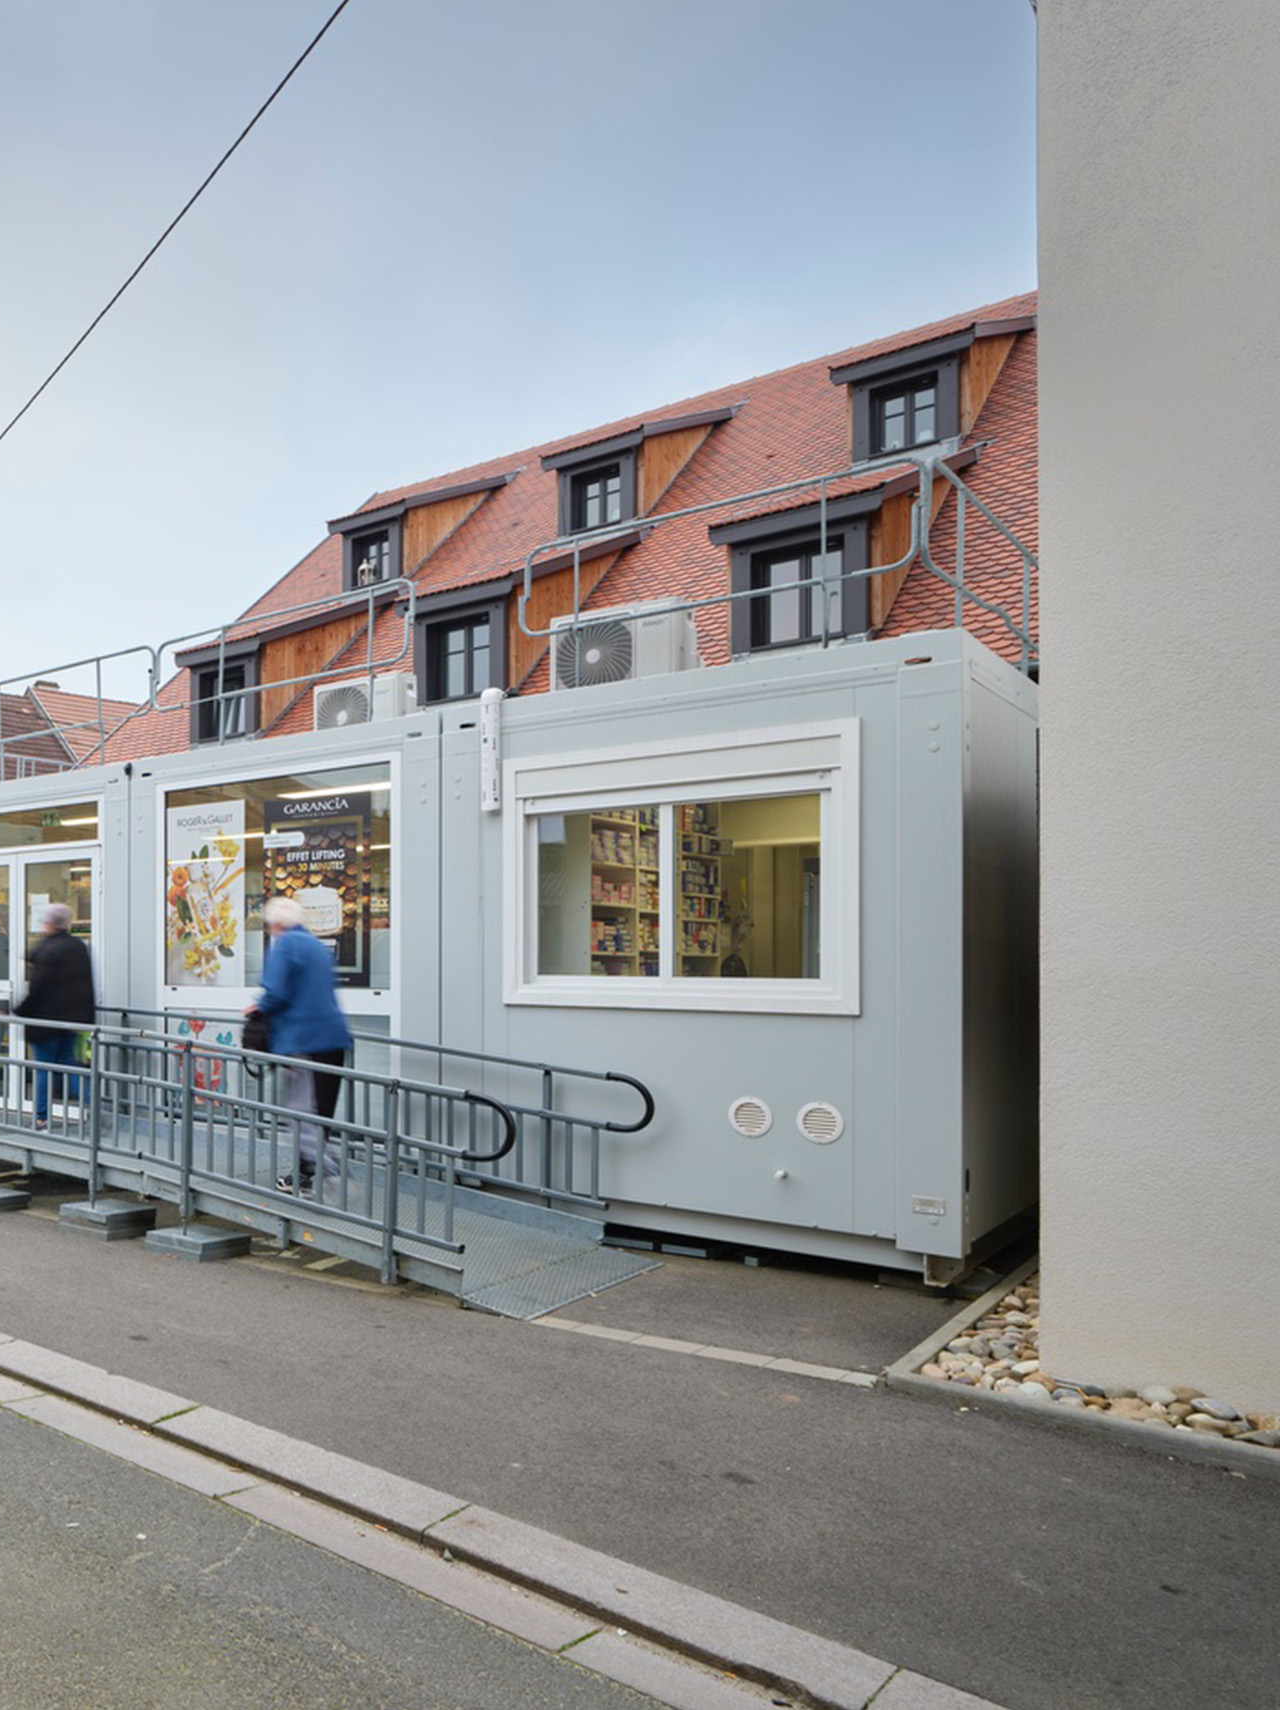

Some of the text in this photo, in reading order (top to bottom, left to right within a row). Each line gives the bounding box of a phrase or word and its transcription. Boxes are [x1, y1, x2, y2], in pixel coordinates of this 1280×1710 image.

[283, 797, 349, 814] GARANCIA
[286, 848, 345, 862] EFFET LIFTING
[298, 862, 308, 872] 30
[309, 860, 345, 871] MINUTES
